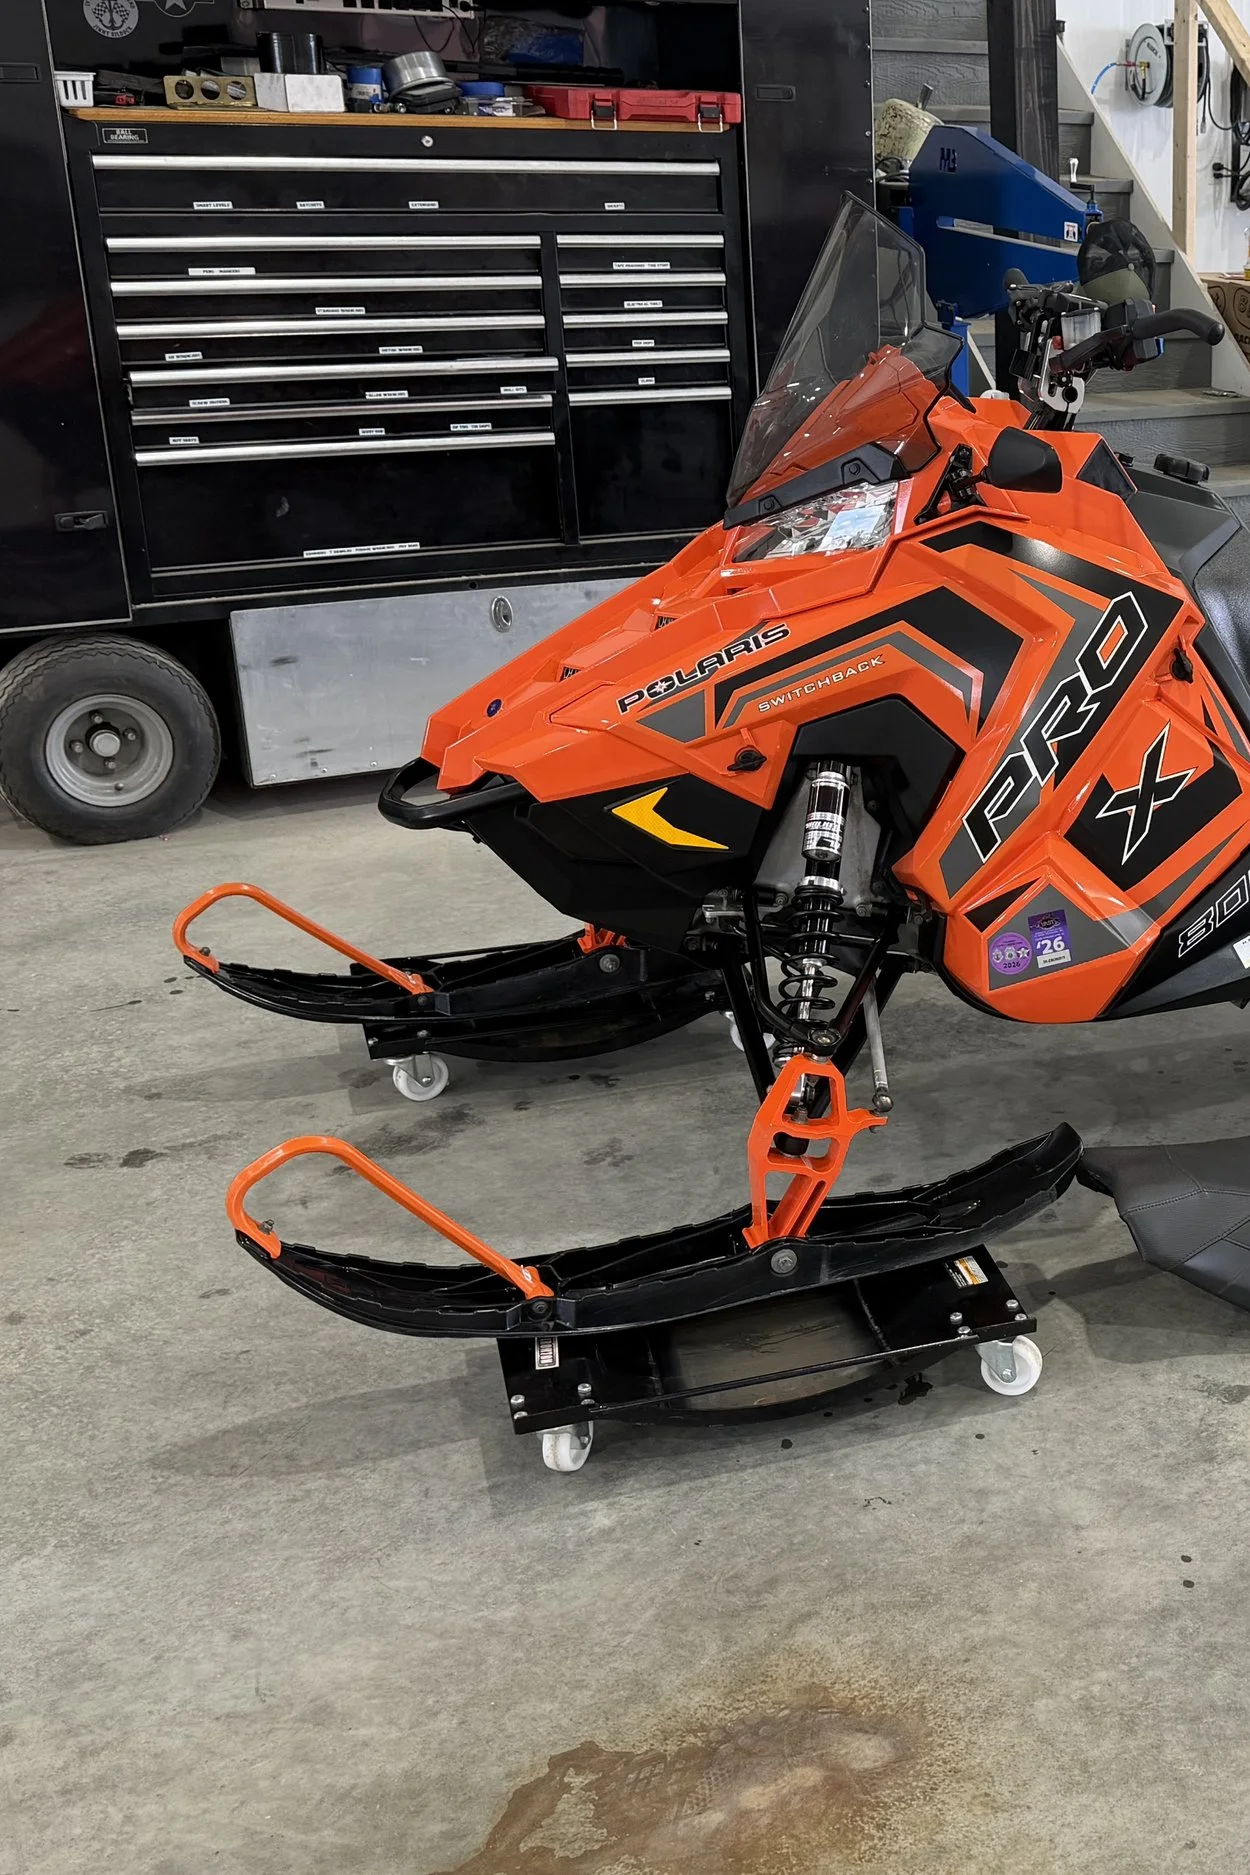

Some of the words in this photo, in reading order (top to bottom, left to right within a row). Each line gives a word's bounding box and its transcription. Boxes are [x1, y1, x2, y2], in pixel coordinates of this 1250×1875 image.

[614, 622, 792, 716] POLARIS
[757, 653, 886, 713] SWITCHBACK
[961, 590, 1149, 864] PRO
[1094, 718, 1200, 866] X
[1003, 961, 1021, 969] 2026
